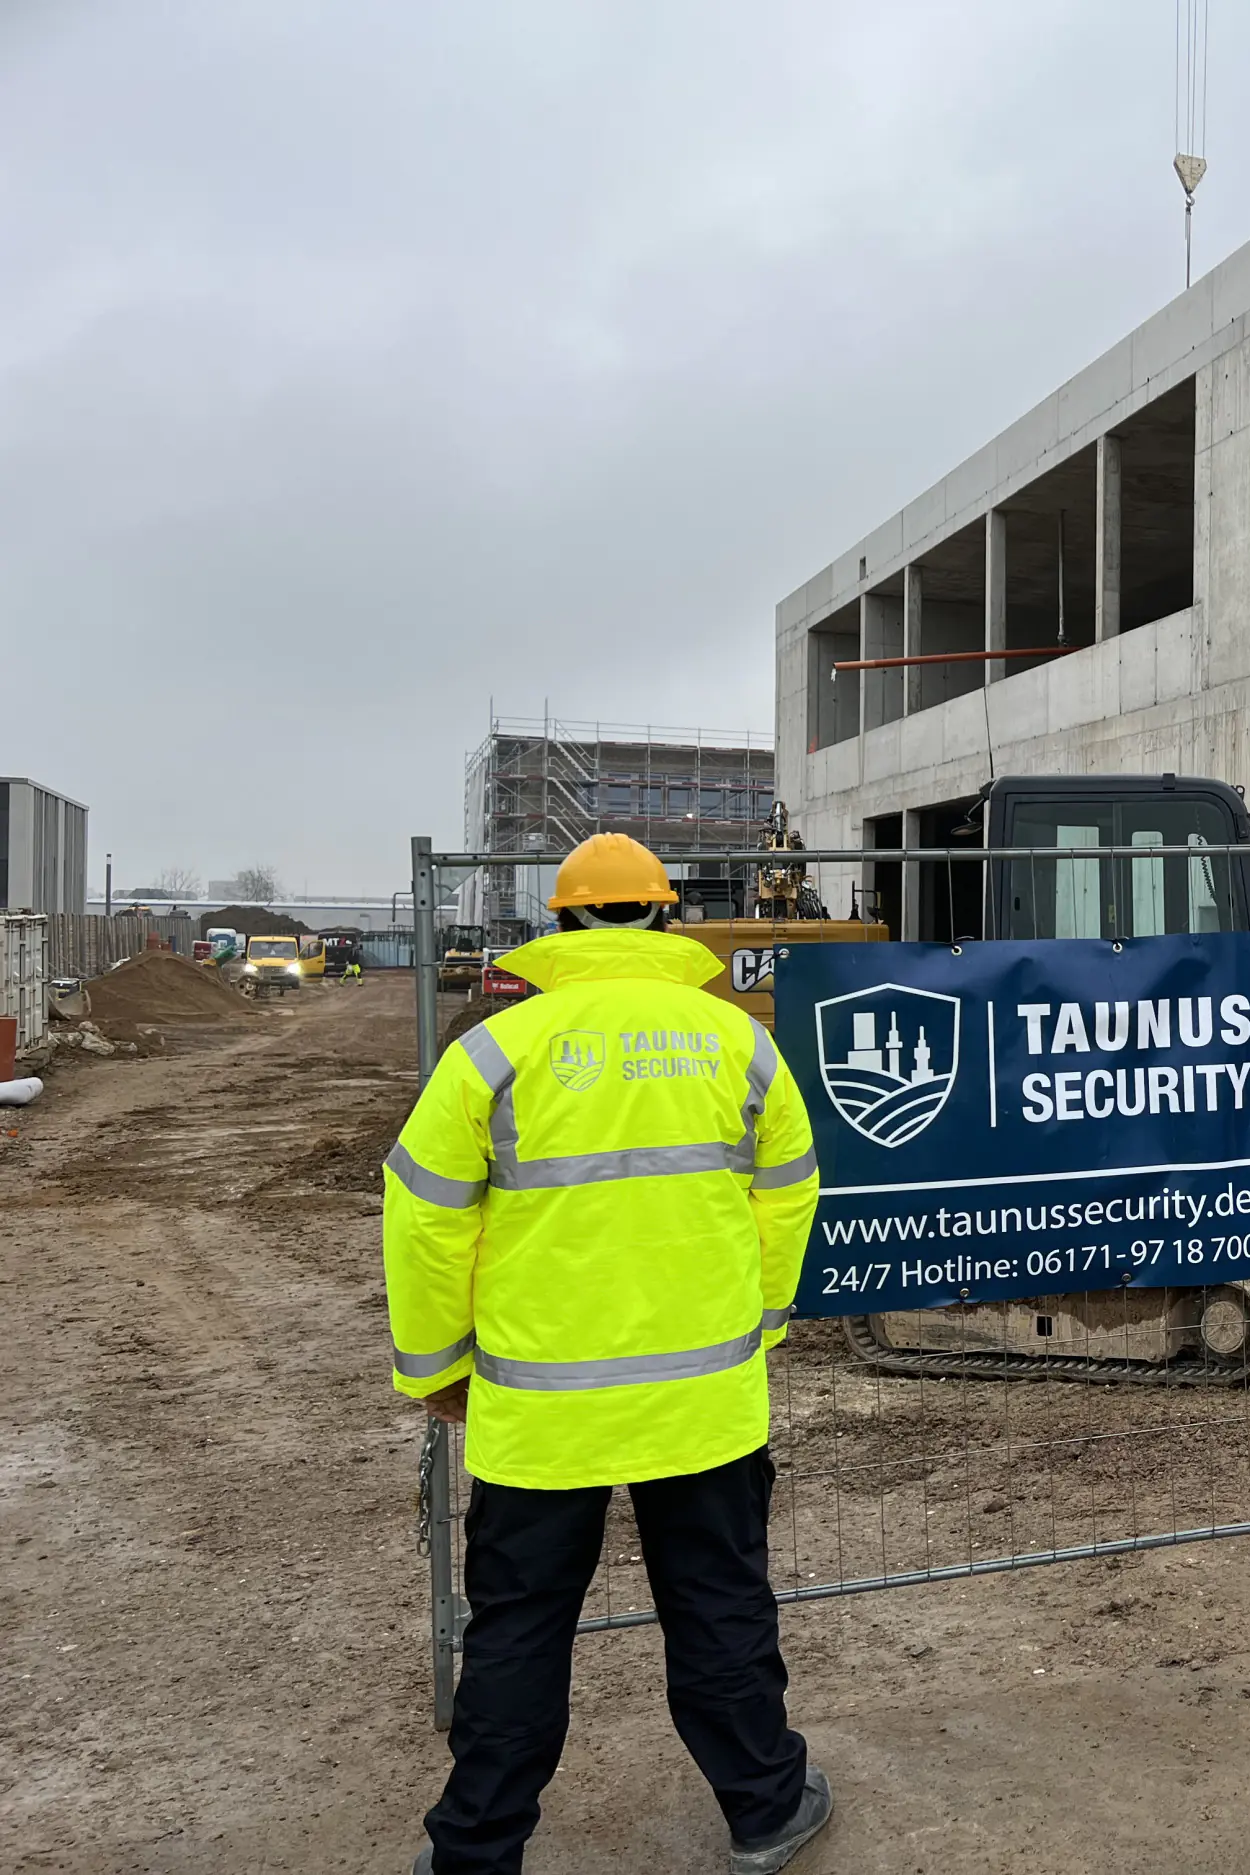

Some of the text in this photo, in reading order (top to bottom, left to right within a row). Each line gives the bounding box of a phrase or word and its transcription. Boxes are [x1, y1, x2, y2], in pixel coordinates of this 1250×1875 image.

[619, 1030, 720, 1053] TAUNUS
[1017, 994, 1250, 1055] TAUNUS
[622, 1057, 721, 1080] SECURITY
[822, 1263, 891, 1294] 24/7
[902, 1255, 1018, 1287] Hotline:
[1173, 1238, 1204, 1264] 18
